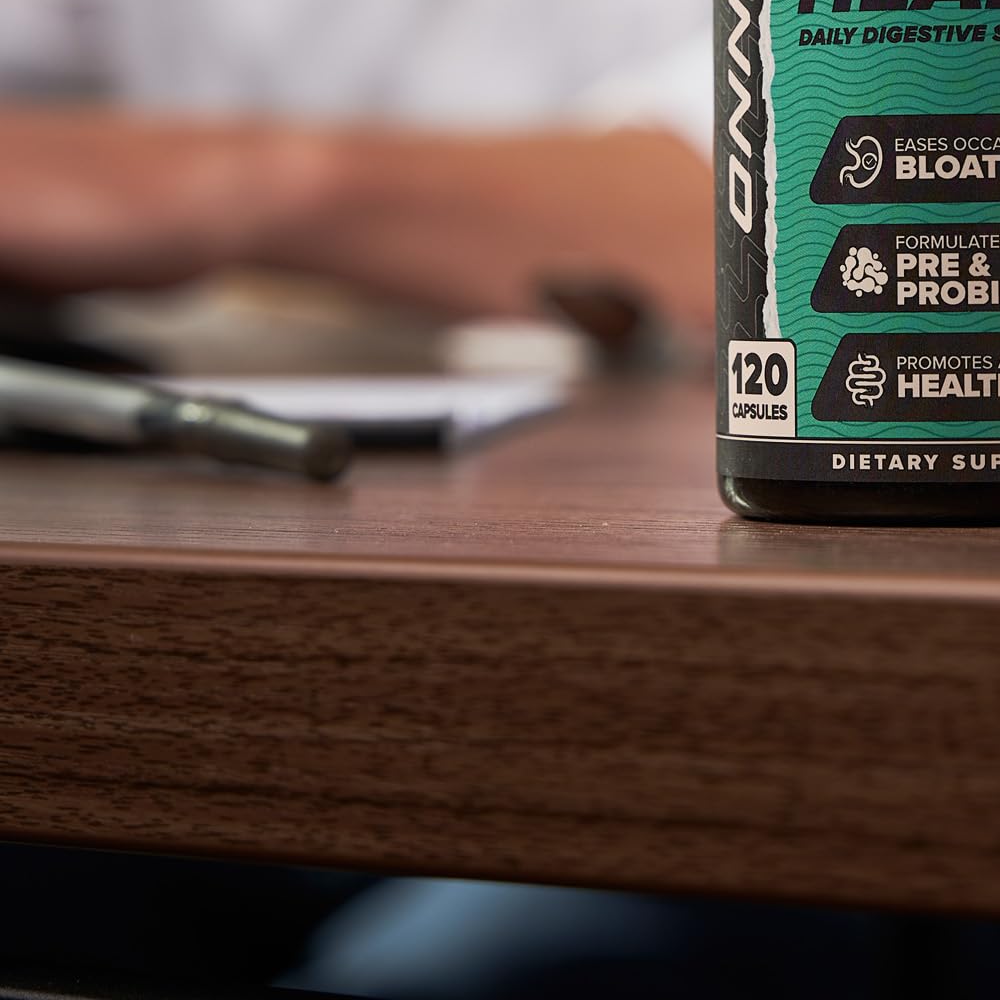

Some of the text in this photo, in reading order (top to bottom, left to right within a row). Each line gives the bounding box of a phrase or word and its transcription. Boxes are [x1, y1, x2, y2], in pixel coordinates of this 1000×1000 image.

[799, 26, 857, 46] DAILY
[861, 24, 988, 44] DIGESTIVE
[895, 138, 948, 152] EASES
[897, 252, 991, 277] PRE &
[896, 355, 993, 370] PROMOTES
[732, 352, 789, 397] 120
[732, 402, 789, 421] CAPSULES
[832, 453, 940, 471] DIETARY
